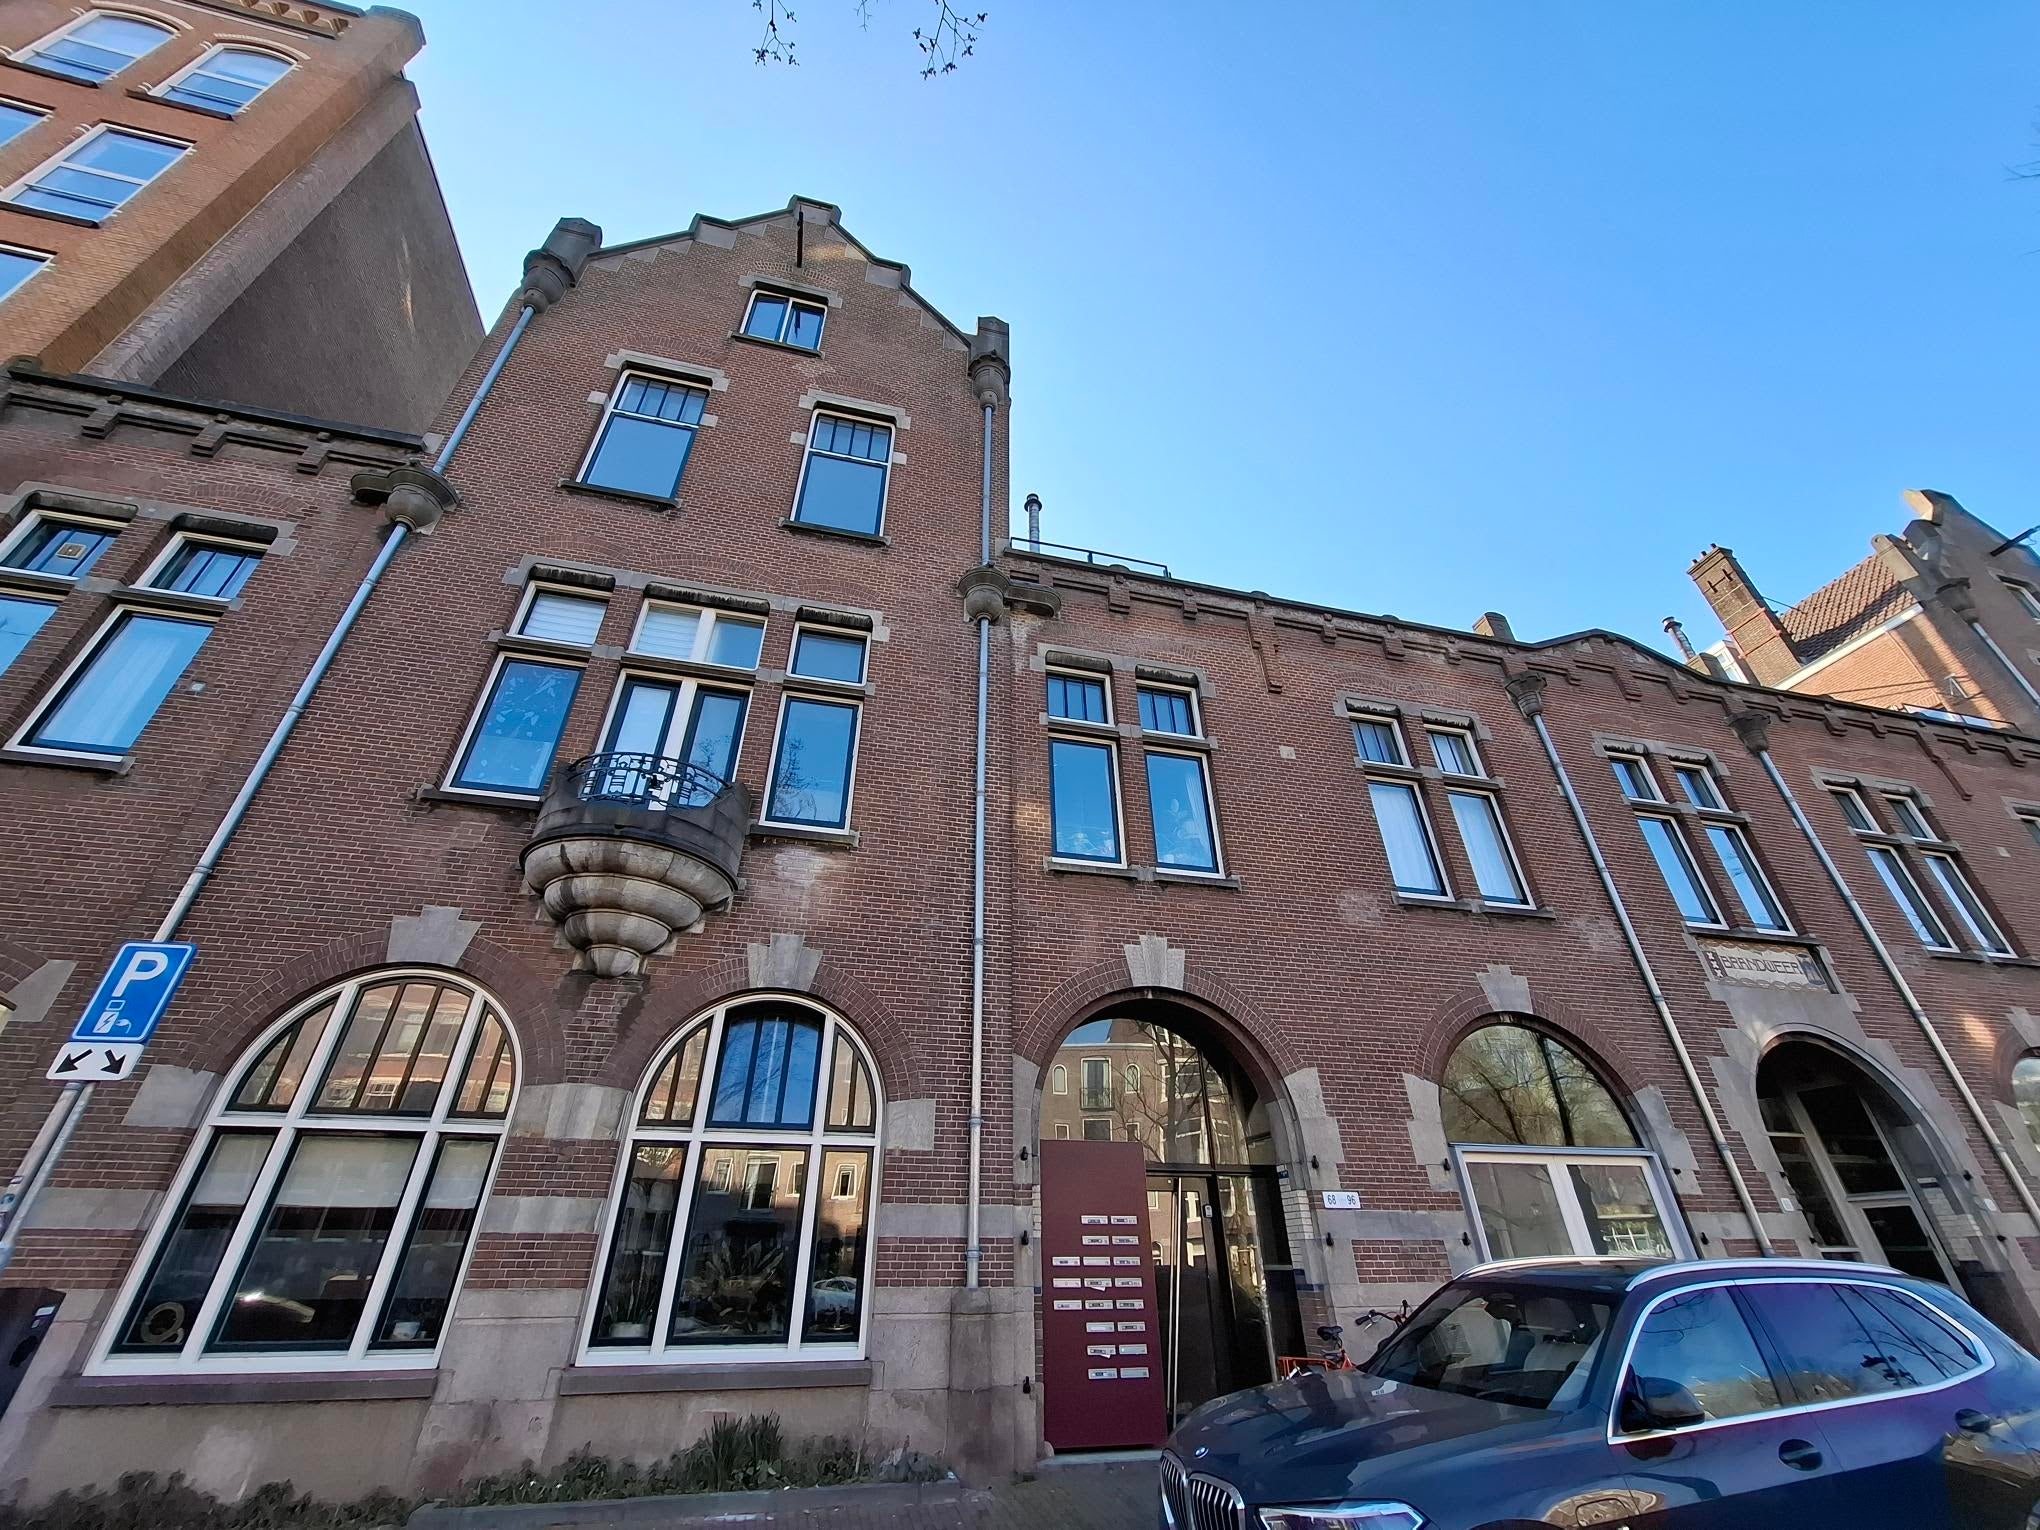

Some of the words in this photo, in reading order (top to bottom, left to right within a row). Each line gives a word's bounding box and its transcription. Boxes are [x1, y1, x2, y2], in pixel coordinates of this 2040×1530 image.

[111, 951, 168, 997] P
[1720, 955, 1803, 974] BRANDWEER
[1327, 1194, 1337, 1206] 68
[1346, 1194, 1357, 1206] 96
